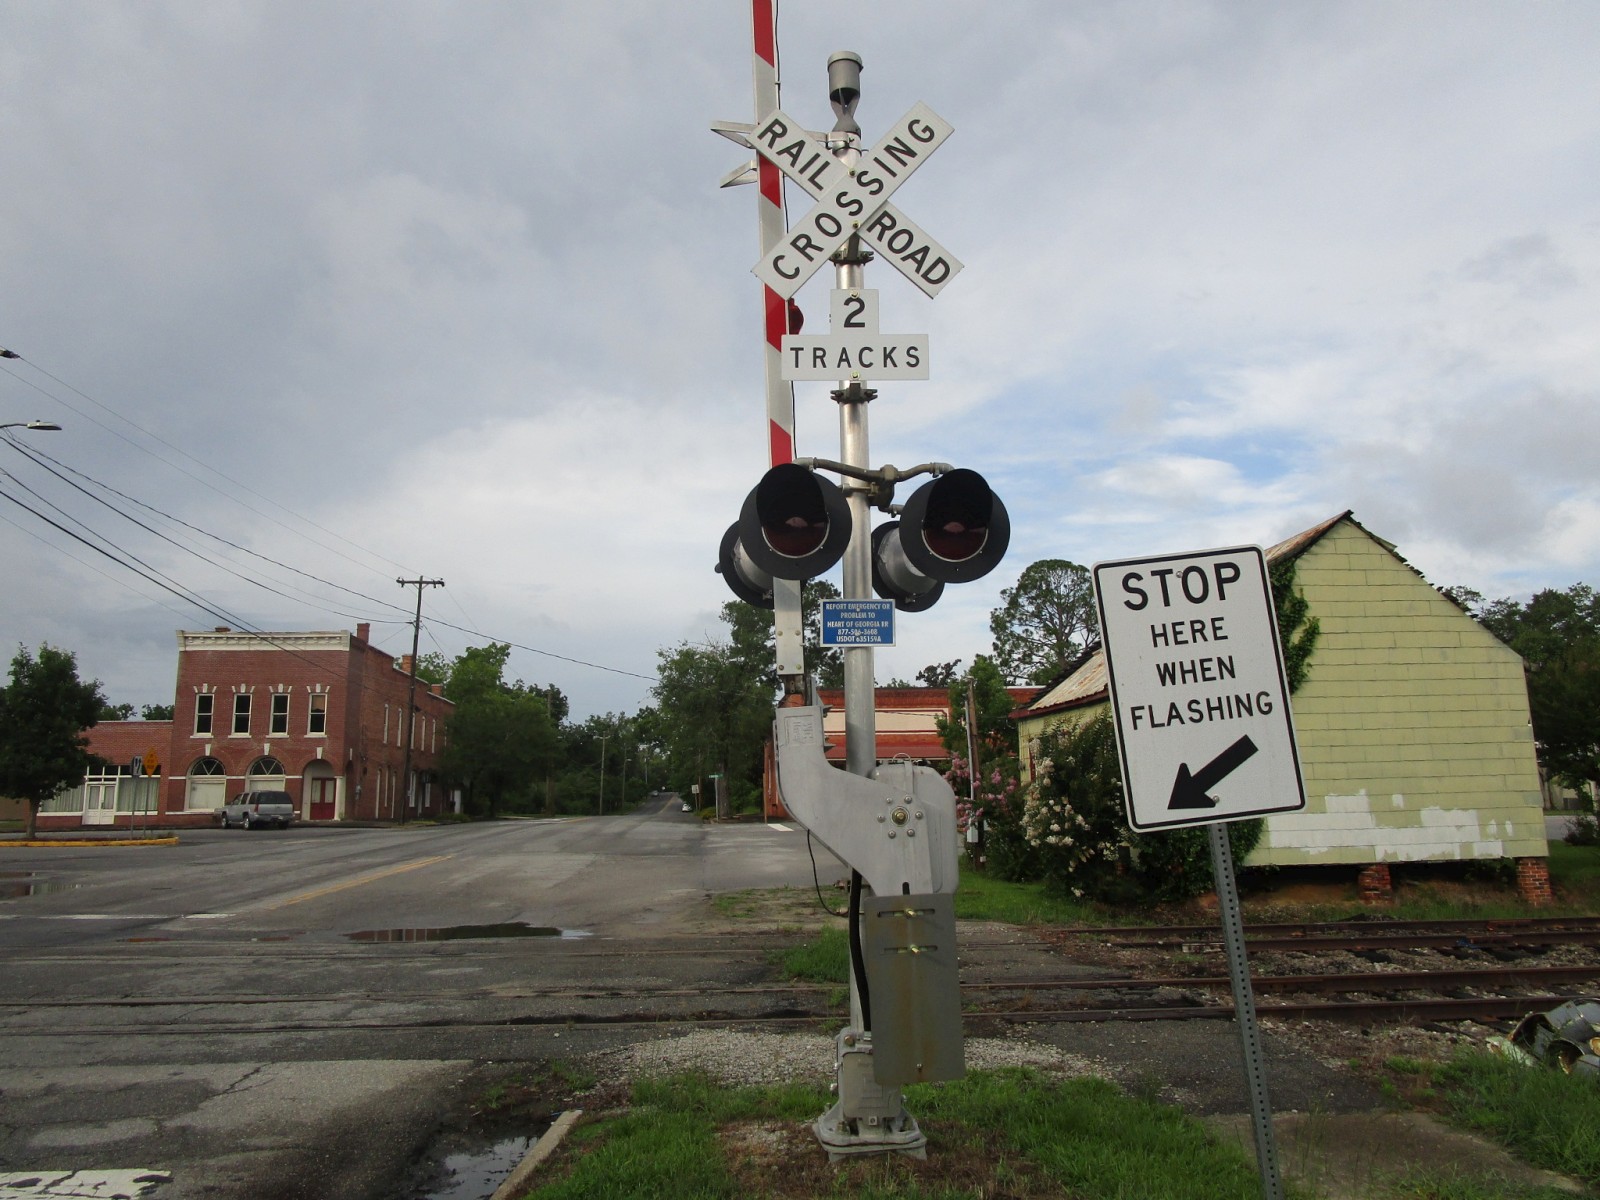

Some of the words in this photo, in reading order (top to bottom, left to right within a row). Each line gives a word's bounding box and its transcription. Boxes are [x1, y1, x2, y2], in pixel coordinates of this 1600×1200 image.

[757, 118, 831, 191] RAIL
[867, 210, 951, 285] ROAD
[772, 119, 935, 280] CROSSING
[843, 297, 866, 328] 2
[790, 346, 920, 368] TRACKS
[1122, 562, 1241, 611] STOP
[1151, 617, 1228, 648] HERE
[1156, 655, 1236, 687] WHEN
[1130, 691, 1273, 731] FLASHING
